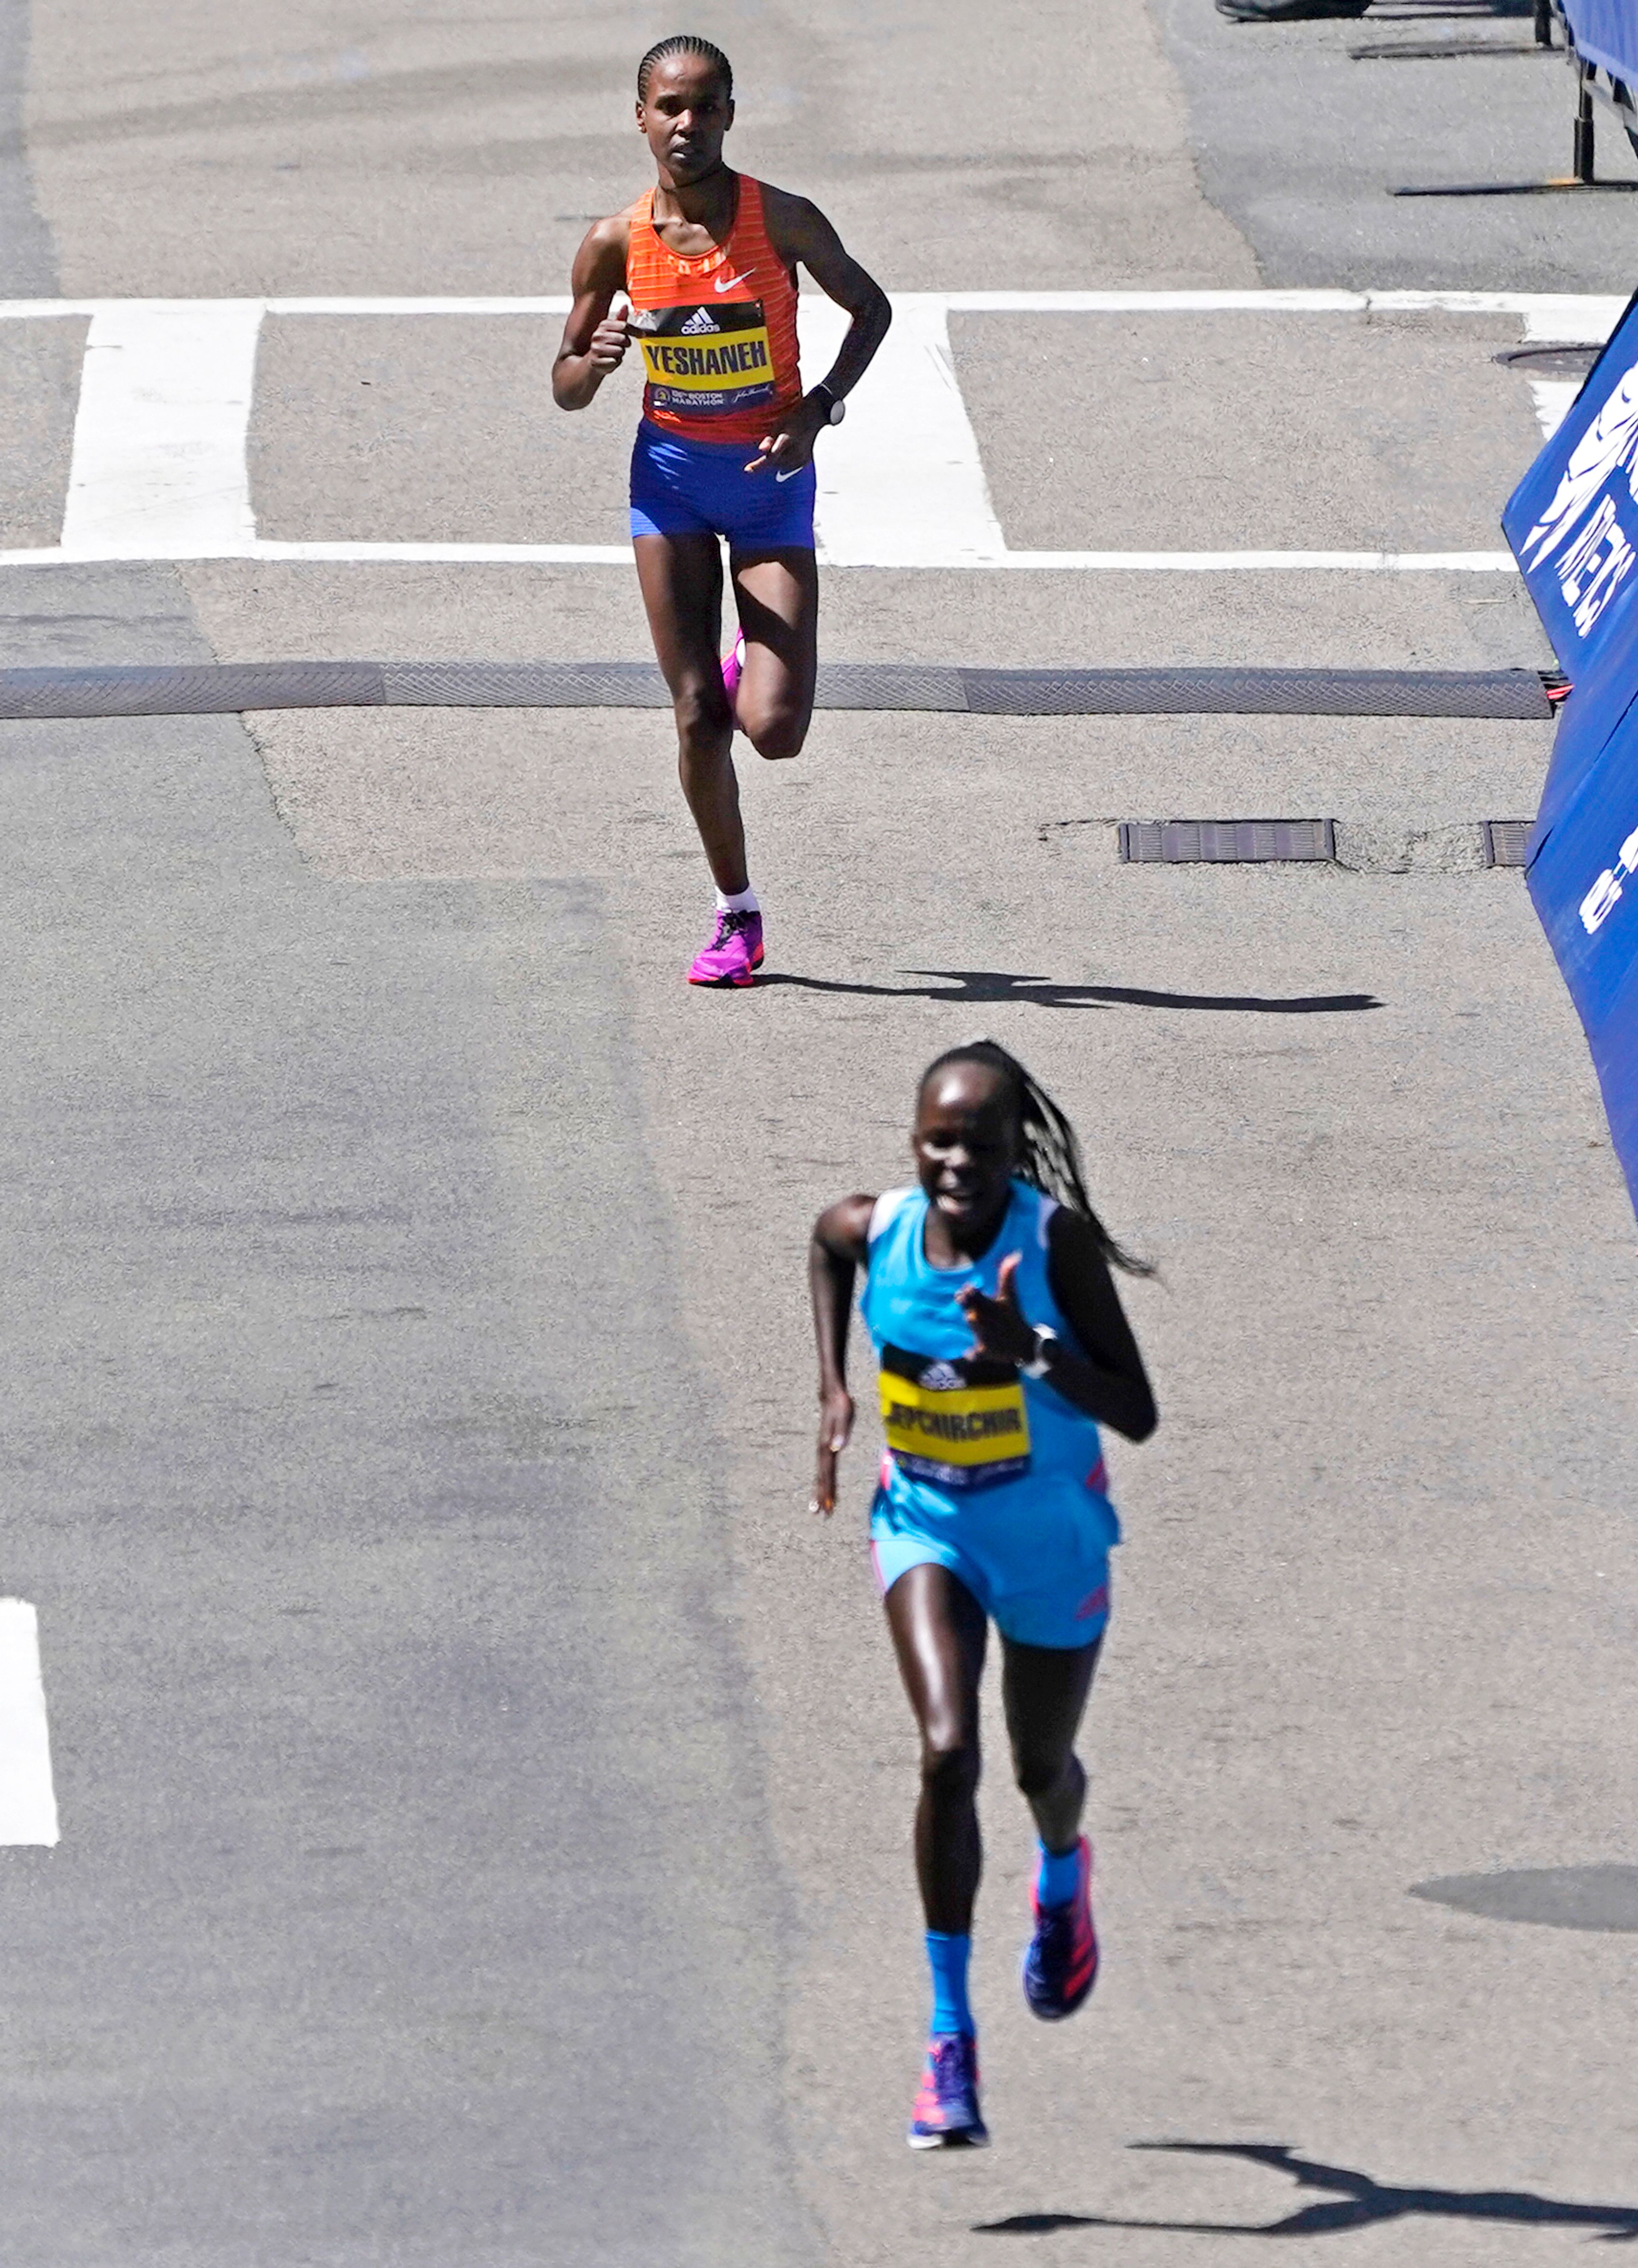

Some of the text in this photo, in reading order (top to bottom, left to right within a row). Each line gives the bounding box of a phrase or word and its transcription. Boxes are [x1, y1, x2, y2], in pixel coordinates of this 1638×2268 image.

[681, 323, 720, 335] adidas
[646, 341, 767, 375] YESHANEH
[671, 397, 724, 406] MARATHON
